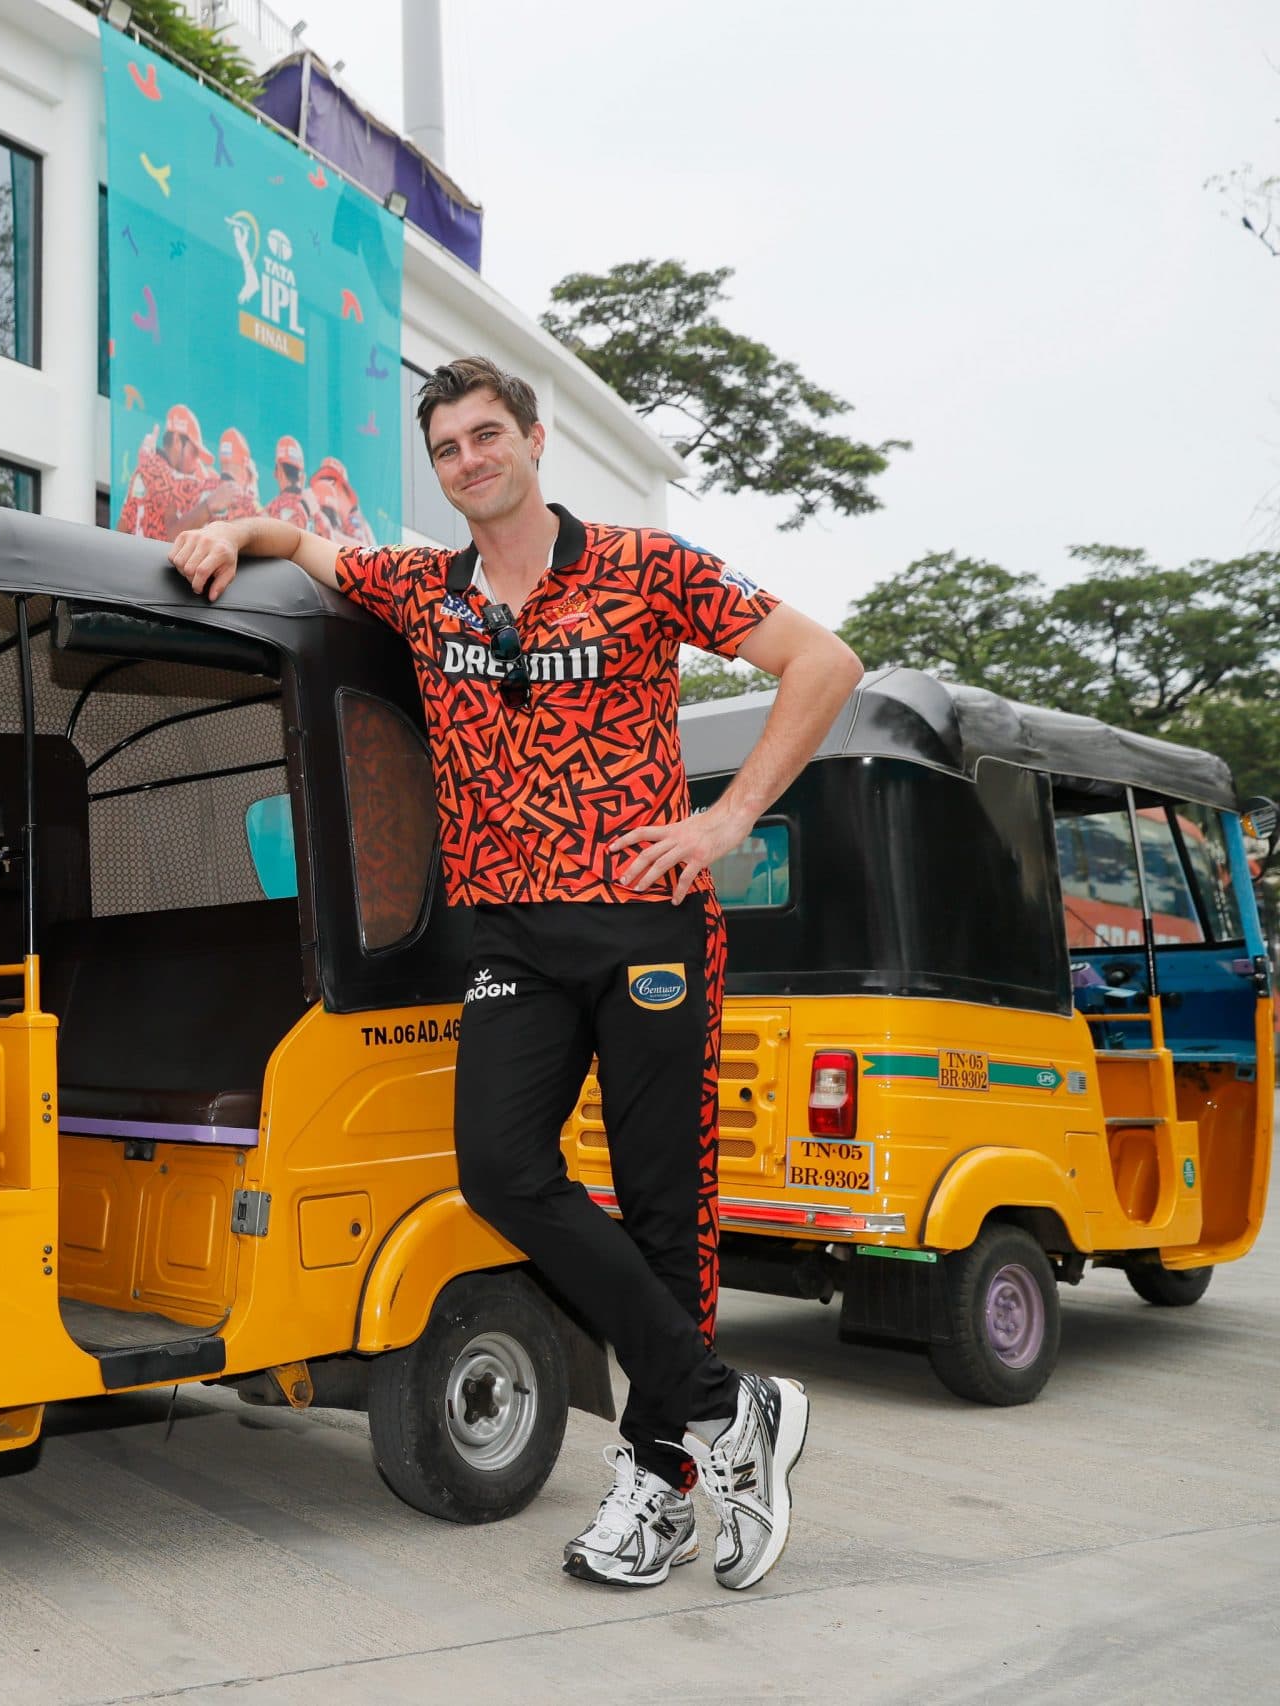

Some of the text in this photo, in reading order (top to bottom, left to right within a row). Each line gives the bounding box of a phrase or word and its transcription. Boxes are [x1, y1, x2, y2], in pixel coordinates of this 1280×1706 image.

[263, 255, 297, 288] TATA
[261, 271, 305, 337] IPL
[254, 321, 289, 356] FINAL
[443, 641, 599, 682] DREM11
[464, 982, 516, 1005] ROGN
